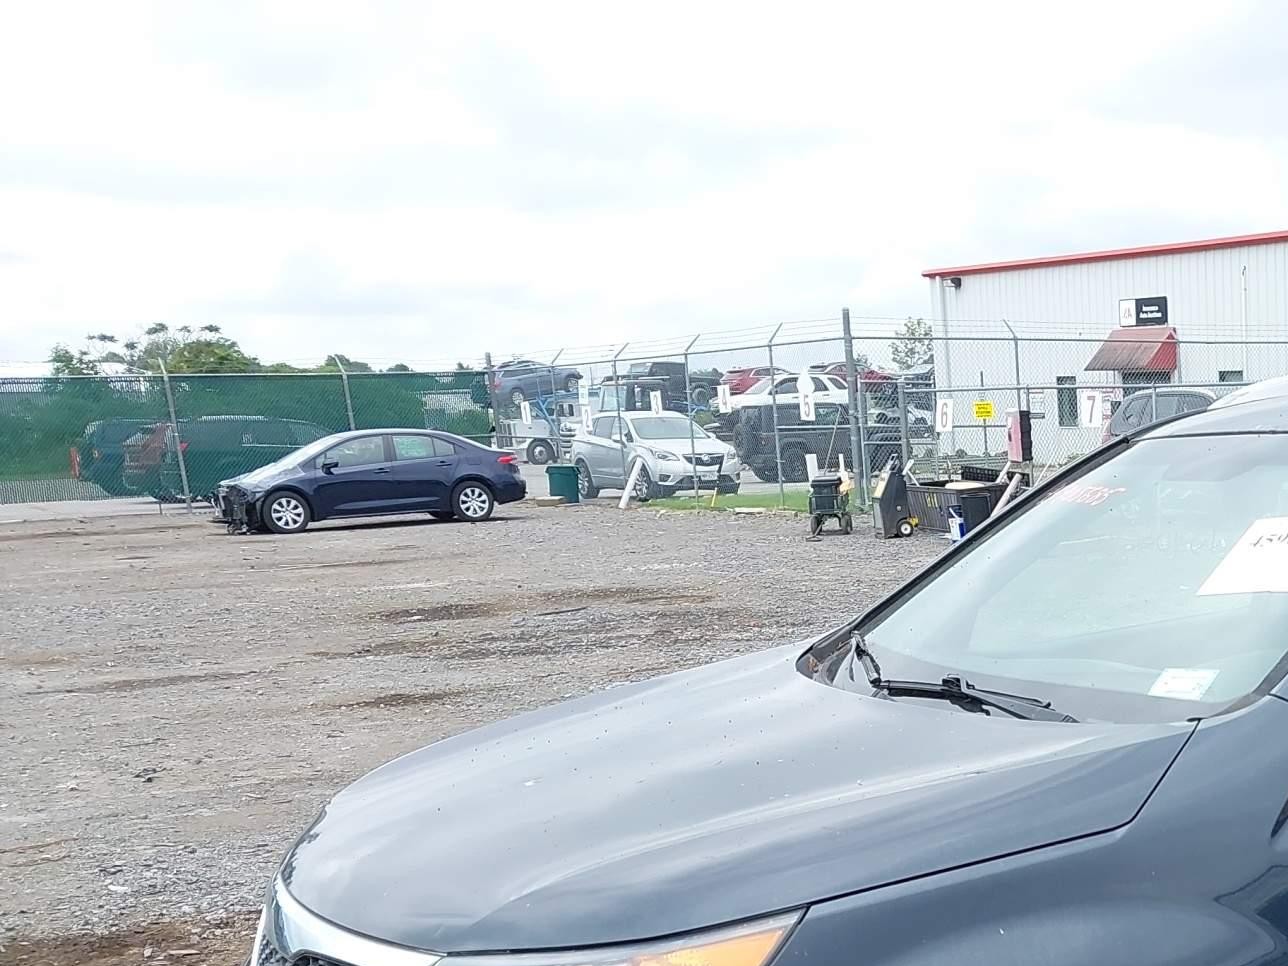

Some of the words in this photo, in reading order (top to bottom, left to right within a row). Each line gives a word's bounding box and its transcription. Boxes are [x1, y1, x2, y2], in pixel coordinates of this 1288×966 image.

[653, 393, 661, 415] 3
[721, 387, 728, 411] 4
[803, 393, 811, 417] 5
[1087, 395, 1096, 423] 7
[940, 402, 948, 428] 6
